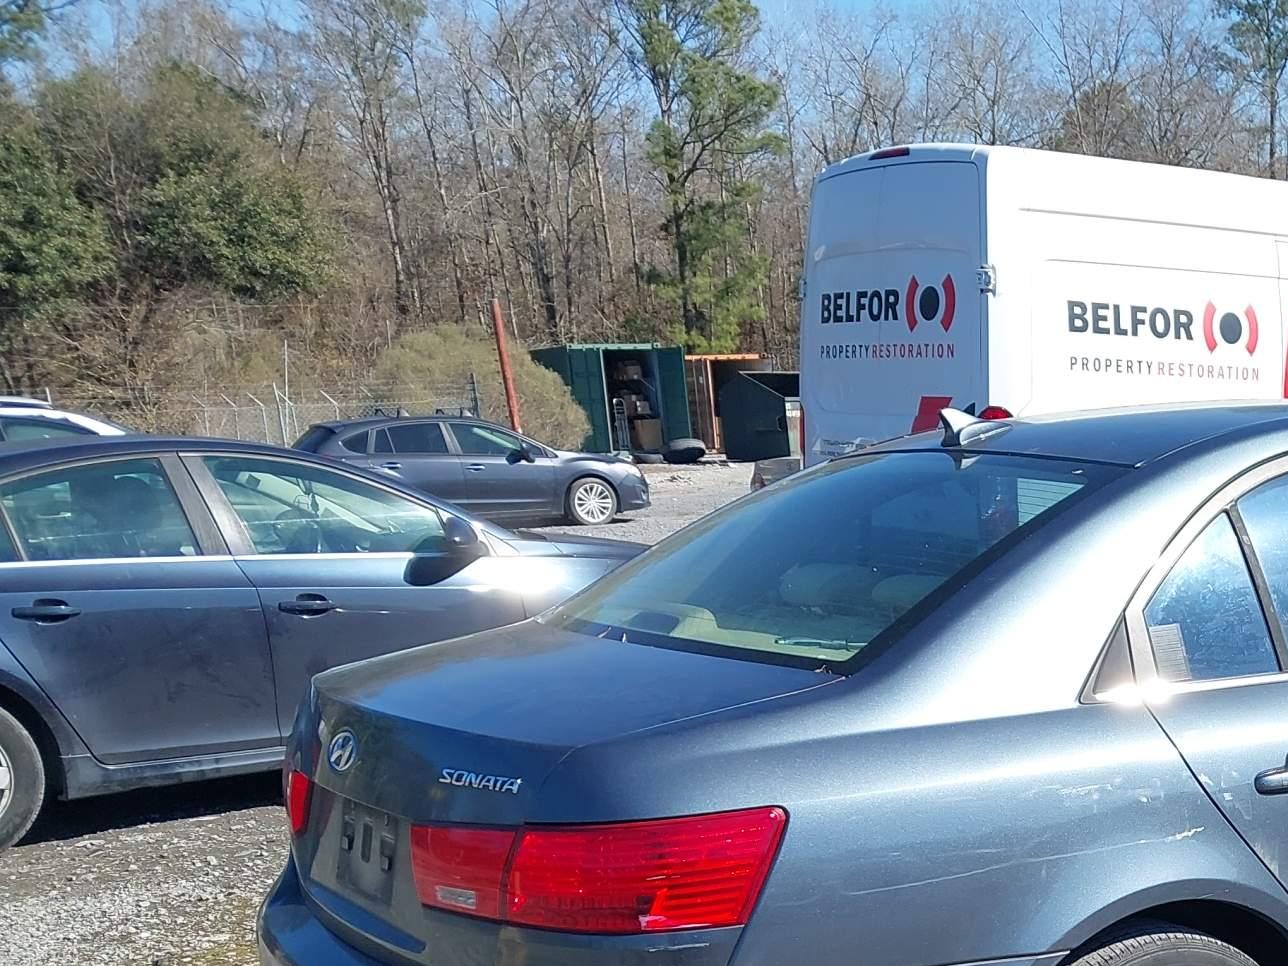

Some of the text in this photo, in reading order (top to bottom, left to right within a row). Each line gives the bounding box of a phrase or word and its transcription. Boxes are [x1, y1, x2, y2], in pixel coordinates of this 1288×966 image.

[820, 288, 900, 325] BELFOR
[1066, 299, 1195, 341] BELFOR
[438, 768, 522, 794] SONATA
